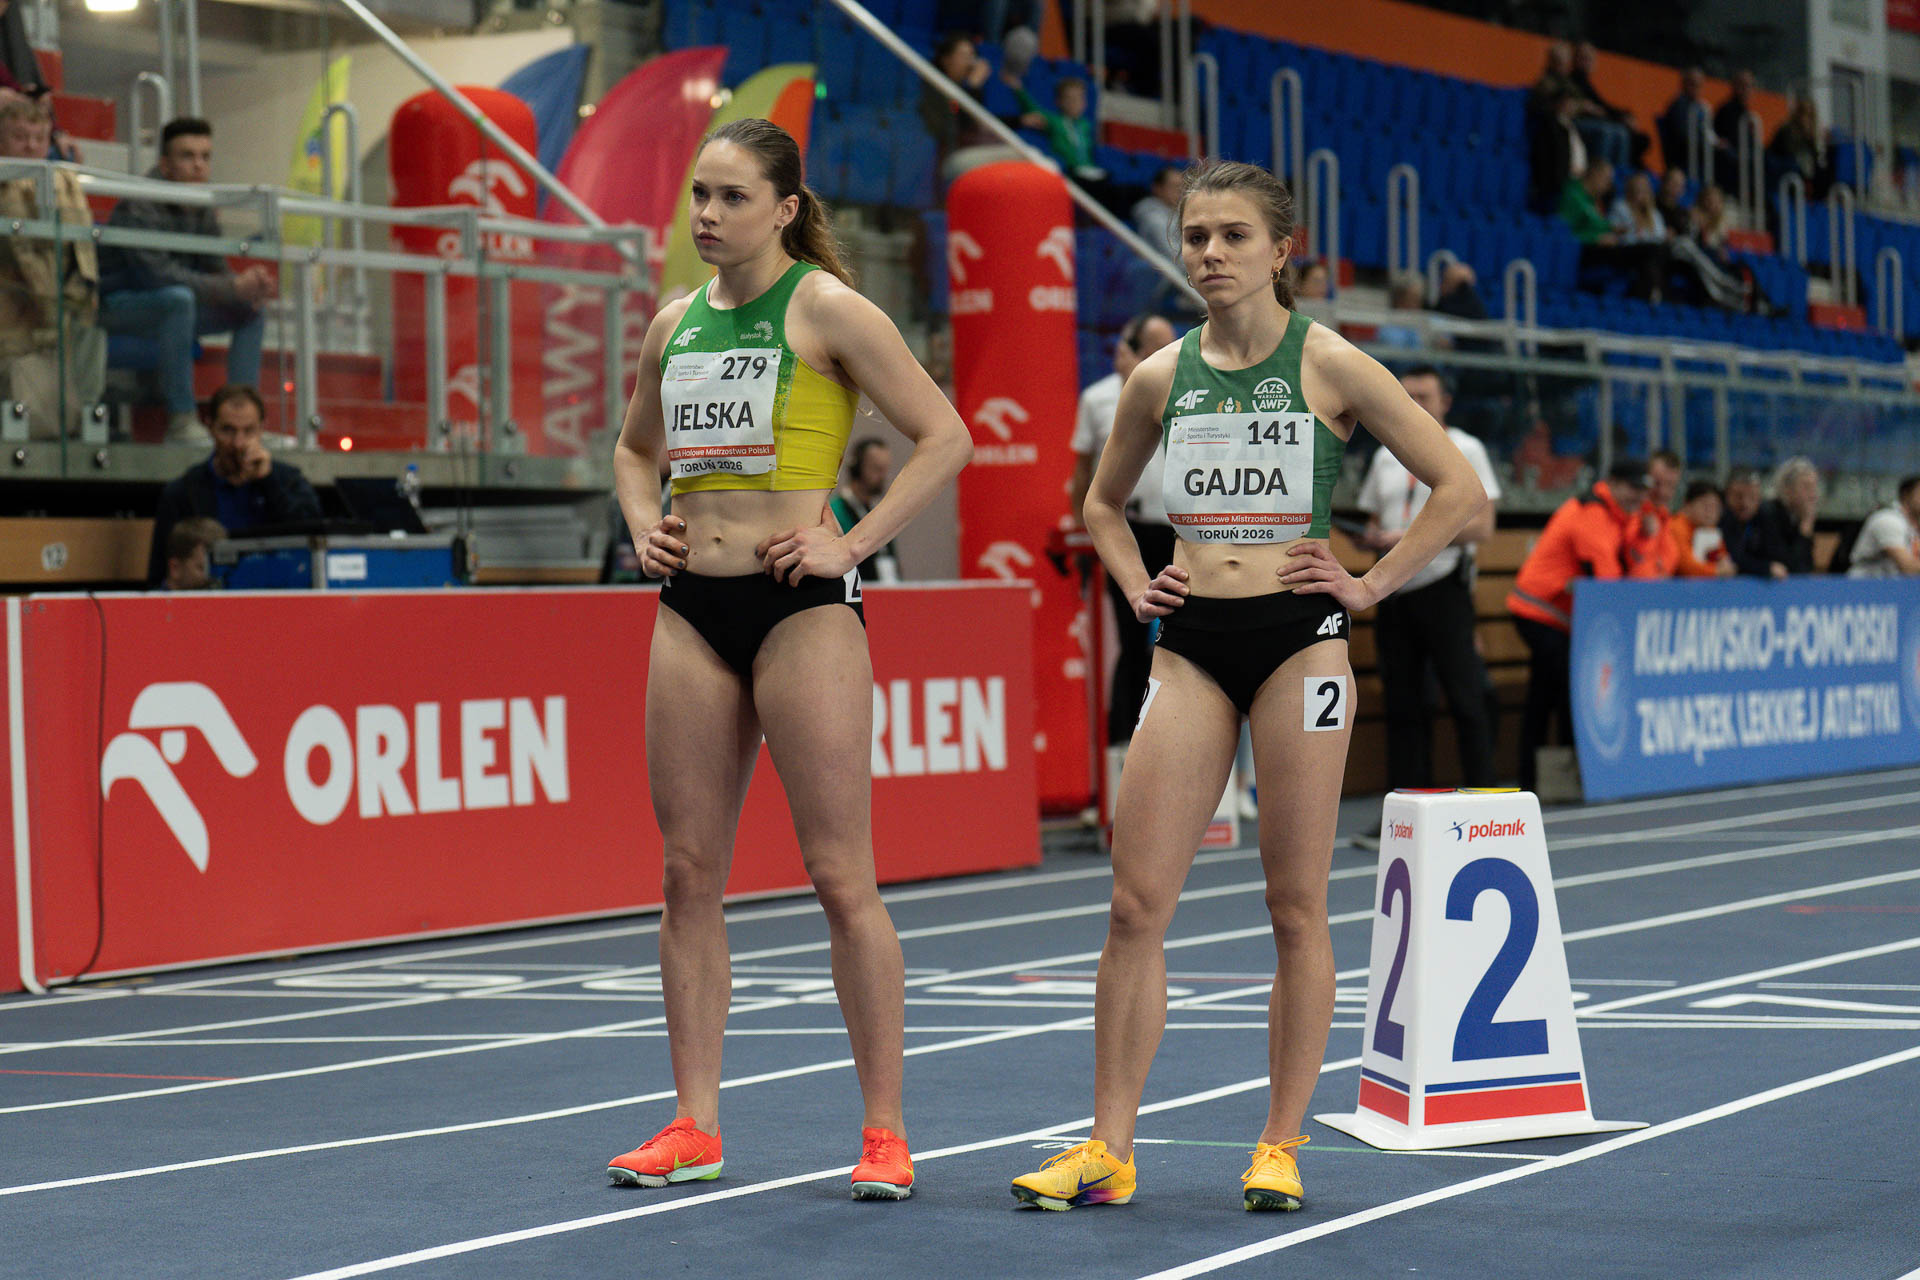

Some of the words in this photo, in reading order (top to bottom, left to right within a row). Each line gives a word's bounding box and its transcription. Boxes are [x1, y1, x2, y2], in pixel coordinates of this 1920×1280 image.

[673, 326, 702, 347] 4F
[720, 356, 768, 380] 279
[1174, 389, 1210, 410] 4F
[1261, 383, 1284, 394] AZS
[1226, 397, 1233, 405] A
[1259, 399, 1286, 410] AWF
[672, 401, 755, 432] JELSKA
[1247, 420, 1300, 446] 141
[705, 447, 747, 457] Mistrzostwa
[748, 446, 770, 455] Polski
[680, 459, 716, 473] TORUŃ
[717, 460, 743, 471] 2026
[1184, 468, 1289, 496] GAJDA
[1182, 515, 1199, 523] PZLA
[1200, 515, 1230, 523] Halowe
[1231, 514, 1280, 523] Mistrzostwa
[1282, 514, 1307, 523] Polski
[1197, 526, 1239, 540] TORUŃ
[1242, 529, 1274, 540] 2026
[1316, 612, 1343, 635] 4F
[1315, 681, 1341, 728] 2
[284, 695, 570, 825] ORLEN
[1393, 822, 1414, 840] polanik
[1468, 818, 1526, 842] polanik
[1372, 857, 1412, 1061] 2
[1445, 857, 1549, 1063] 2
